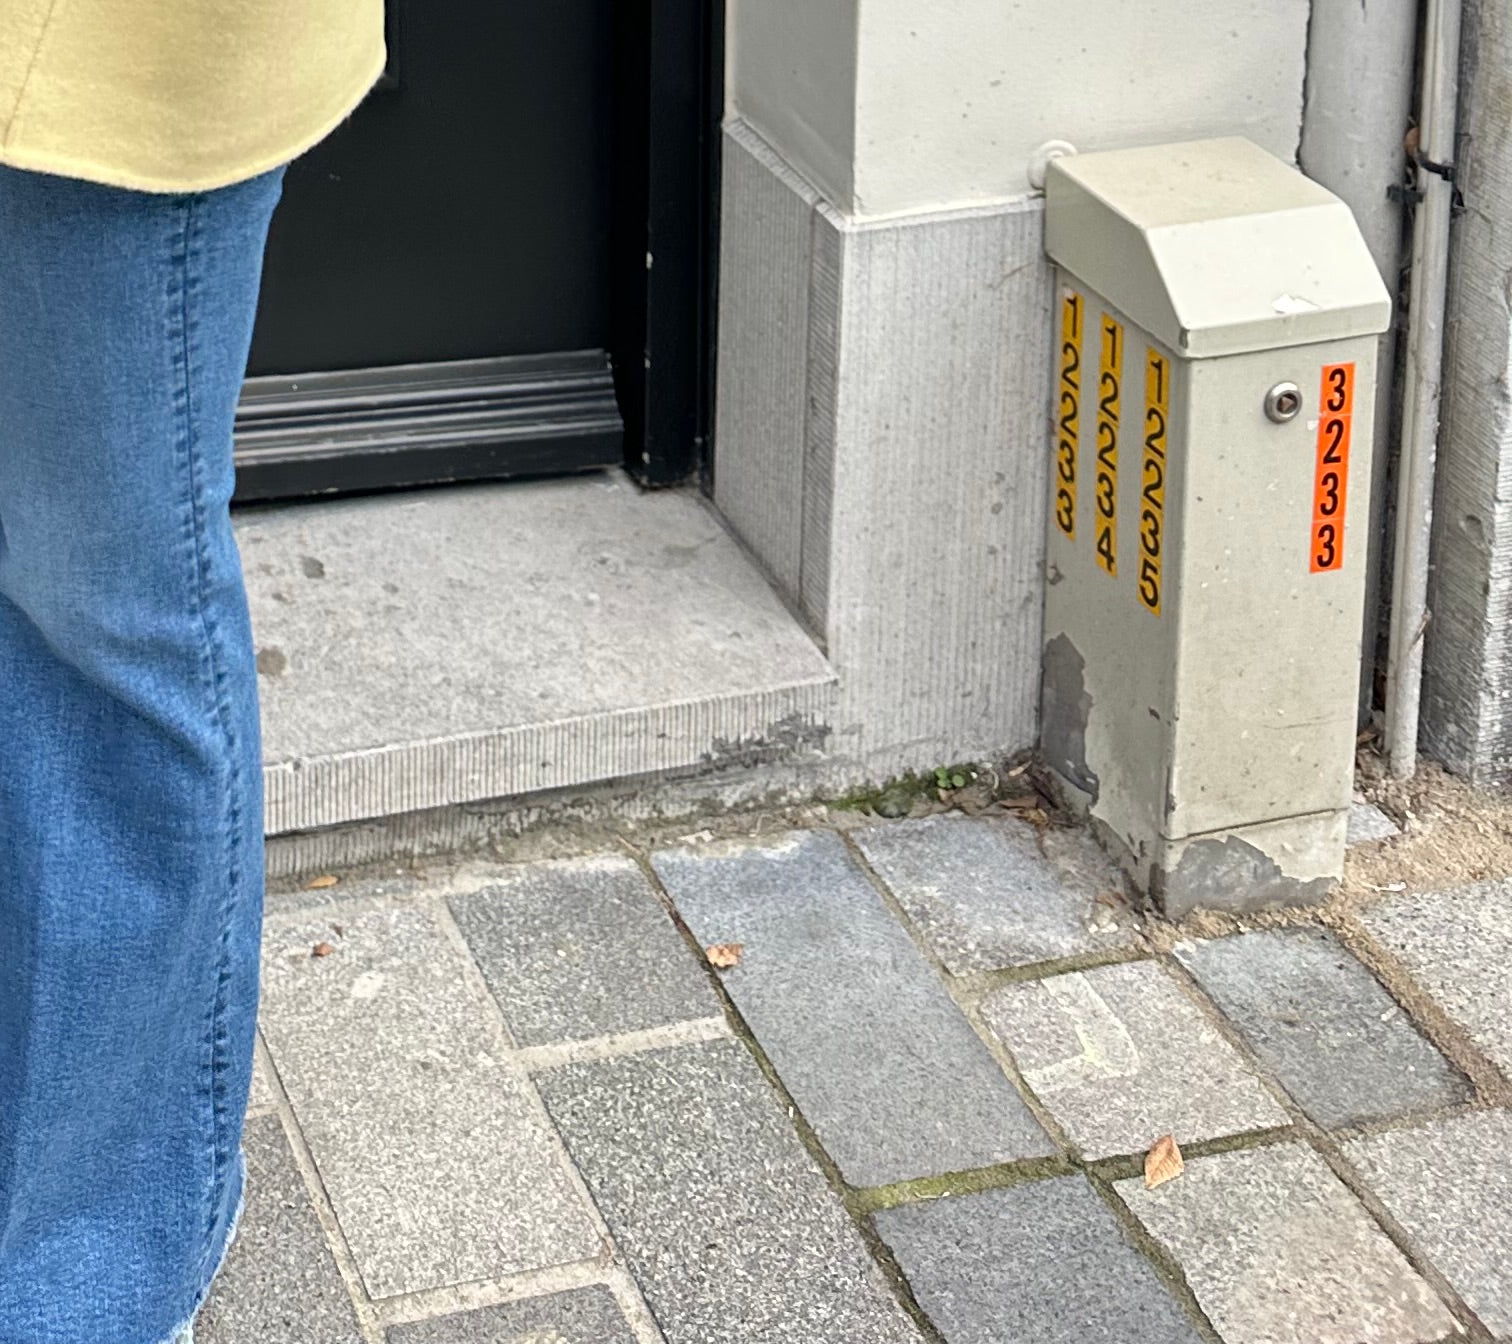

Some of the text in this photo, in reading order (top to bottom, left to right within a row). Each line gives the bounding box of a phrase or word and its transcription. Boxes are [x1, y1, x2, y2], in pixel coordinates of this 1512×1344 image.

[1056, 296, 1080, 534] 12233
[1097, 324, 1119, 572] 12234
[1139, 359, 1165, 608] 12235
[1316, 367, 1346, 568] 3233
